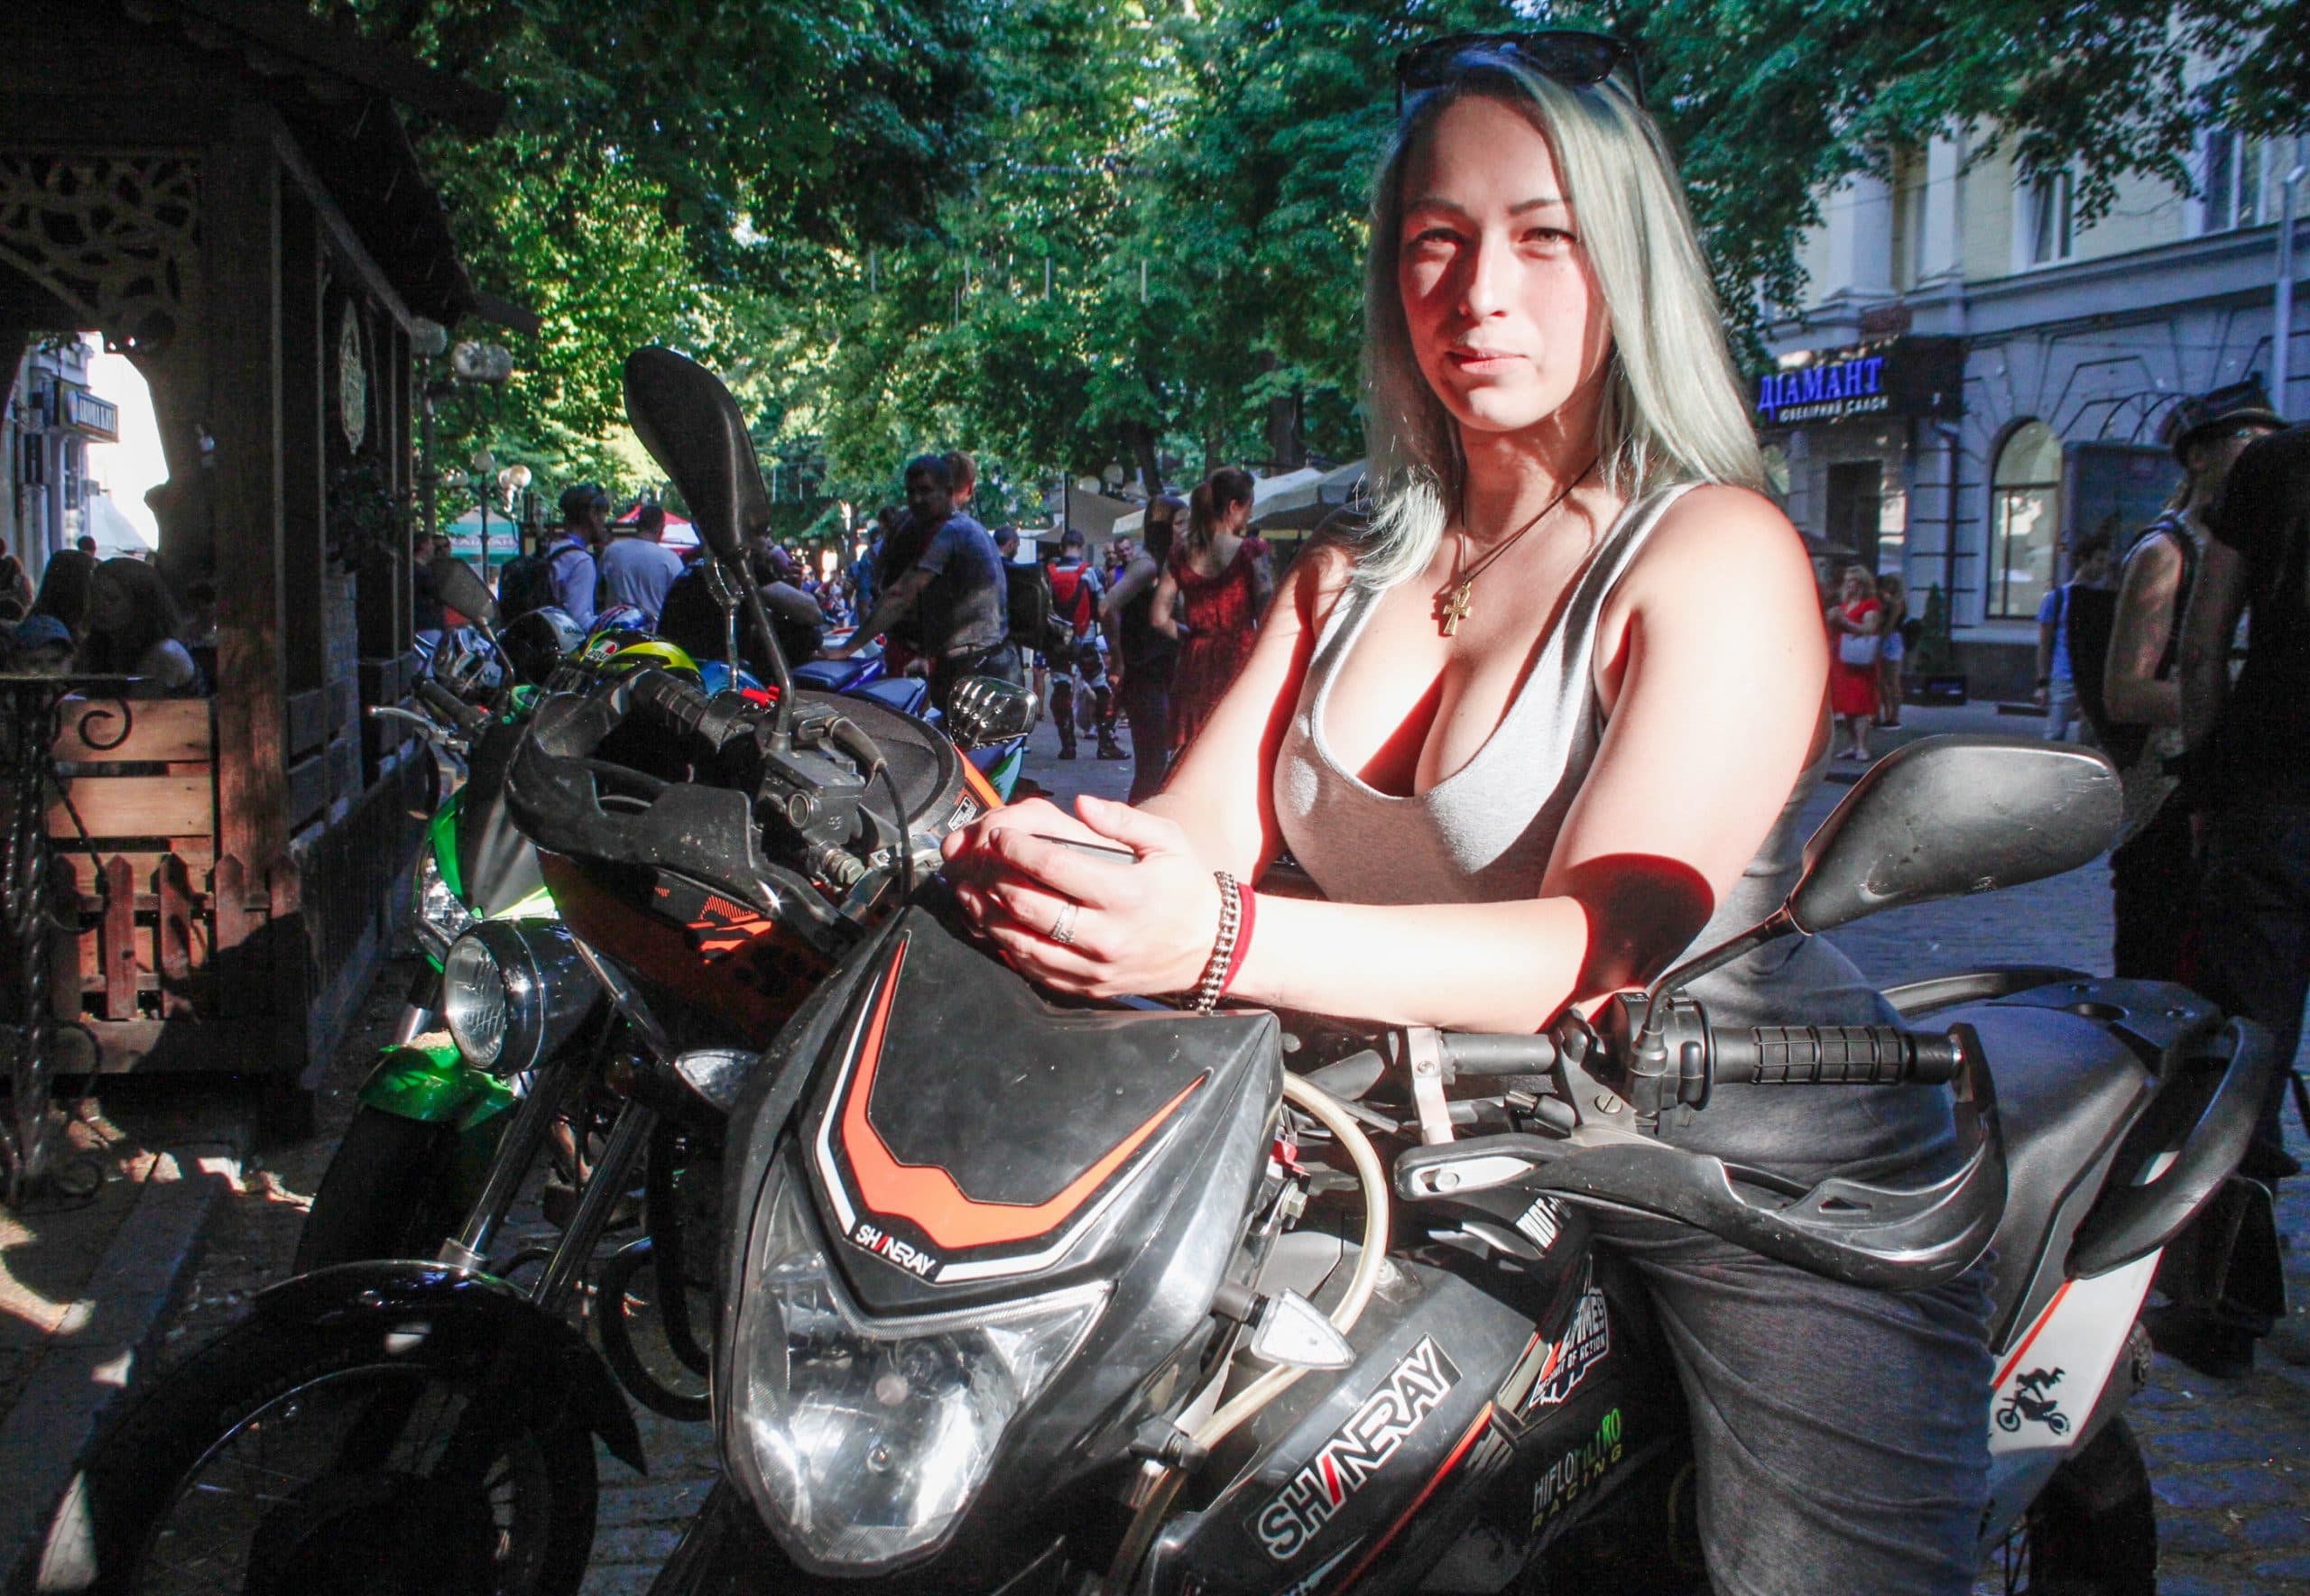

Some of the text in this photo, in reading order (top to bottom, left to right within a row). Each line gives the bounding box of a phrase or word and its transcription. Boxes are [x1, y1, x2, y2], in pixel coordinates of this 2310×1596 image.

[1757, 356, 1884, 422] ДІАМАНТ
[855, 1224, 936, 1276] SHINERAY
[1579, 1333, 1606, 1361] ACTION
[1258, 1338, 1452, 1560] SHINERAY
